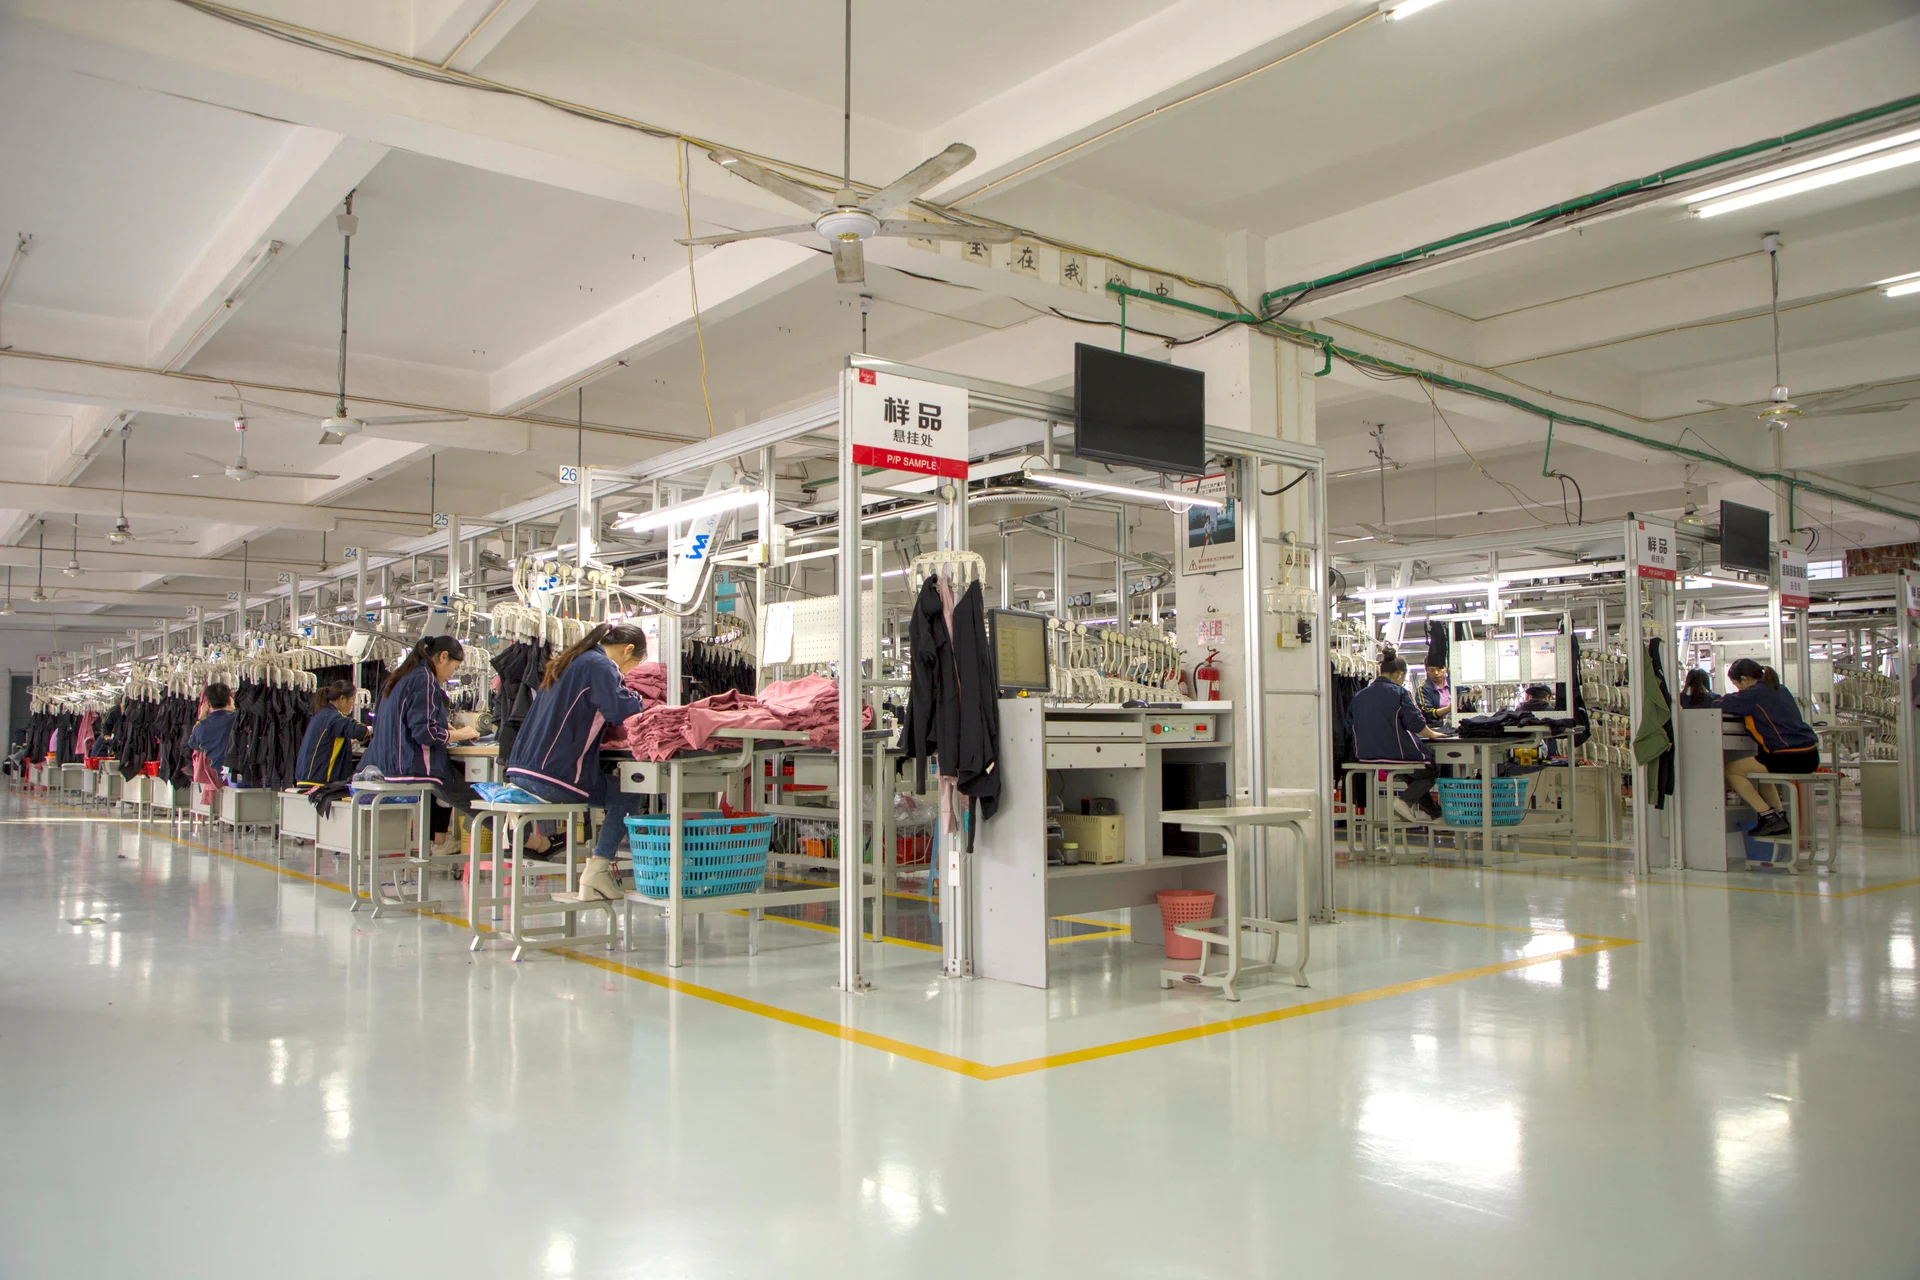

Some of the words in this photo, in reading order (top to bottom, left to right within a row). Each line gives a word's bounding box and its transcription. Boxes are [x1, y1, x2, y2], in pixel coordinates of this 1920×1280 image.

[884, 396, 942, 431] 样品
[892, 429, 934, 448] 悬挂处
[886, 454, 901, 465] P/P
[903, 456, 937, 470] SAMPLE
[561, 467, 577, 482] 26
[434, 513, 449, 526] 25
[345, 547, 357, 558] 24
[279, 573, 290, 583] 23
[227, 591, 239, 600] 22
[187, 607, 197, 615] 21
